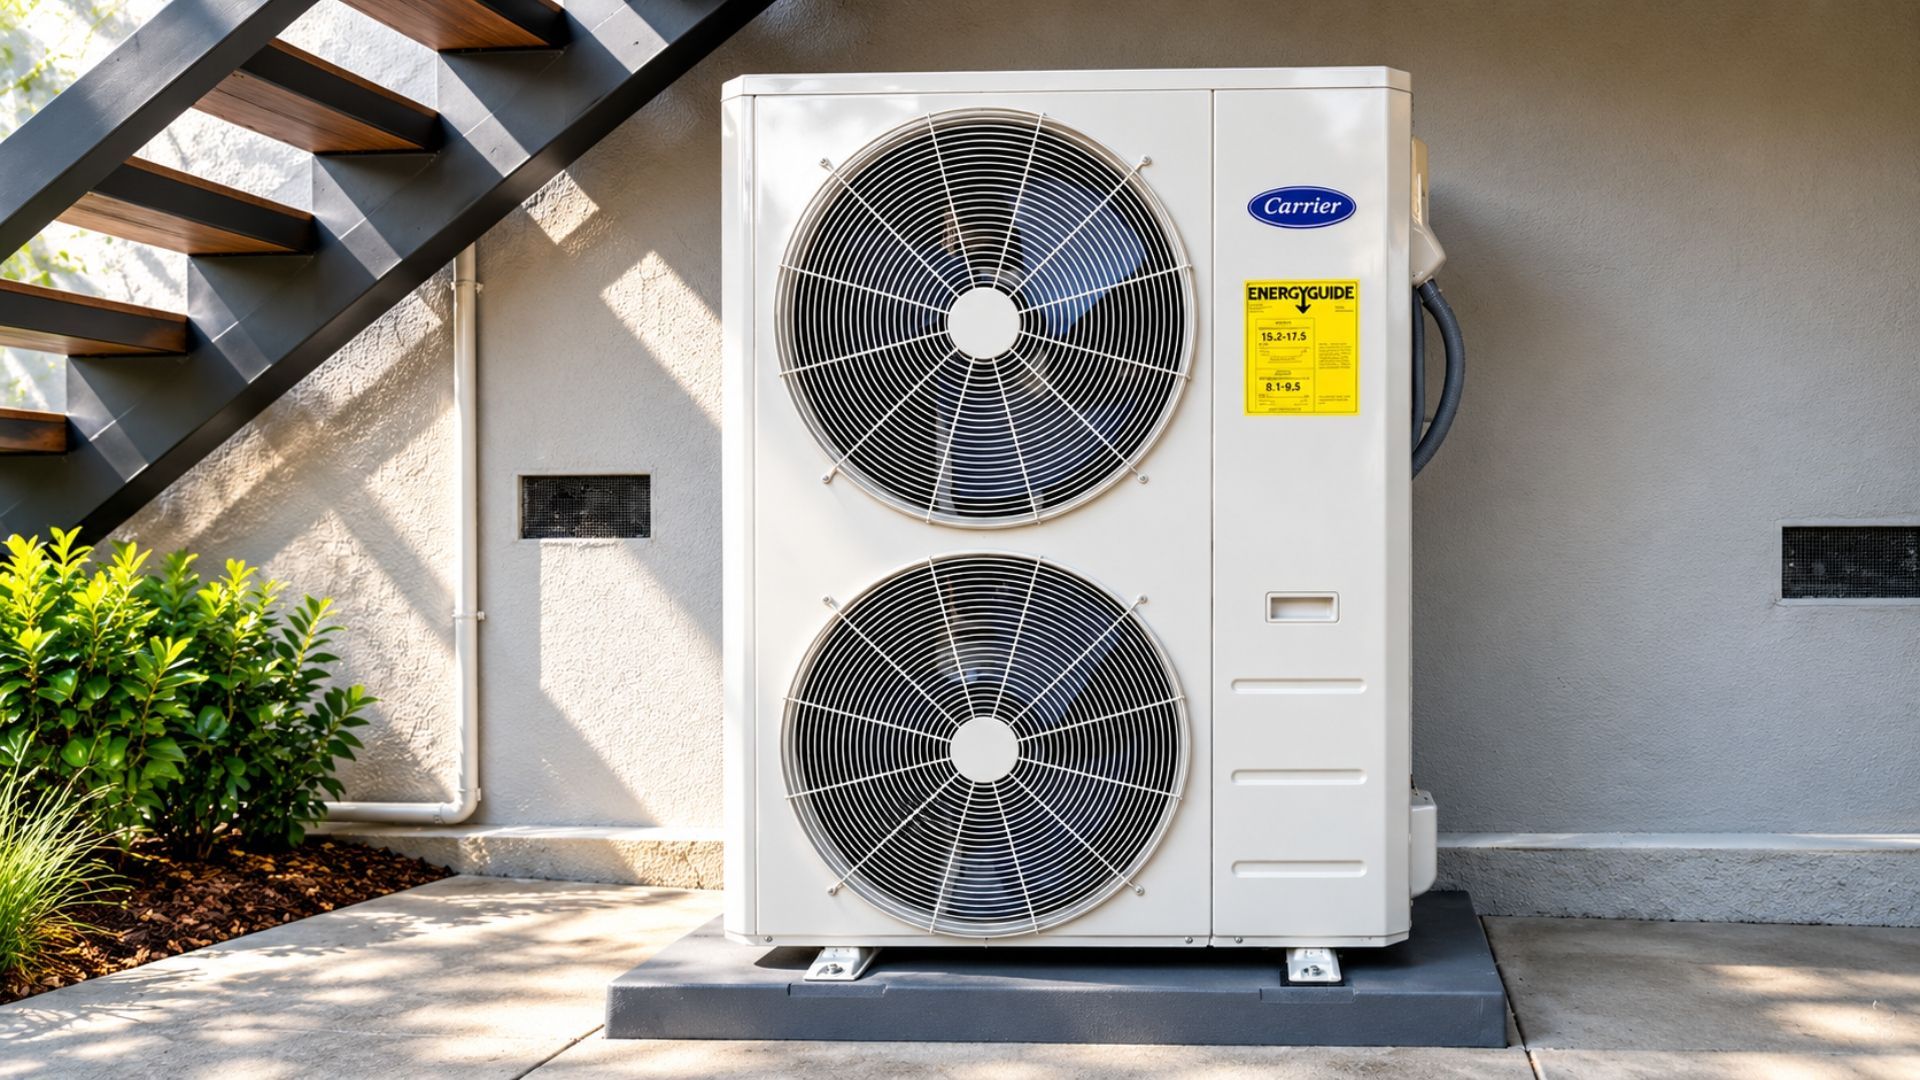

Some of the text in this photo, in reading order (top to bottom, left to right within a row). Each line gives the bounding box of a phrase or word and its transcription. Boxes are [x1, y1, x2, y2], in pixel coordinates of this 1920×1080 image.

[1264, 197, 1342, 215] Carrier
[1248, 286, 1354, 301] ENERGYGUIDE
[1261, 331, 1307, 342] 15.2-17.5
[1265, 382, 1301, 392] 8.1-9.5
